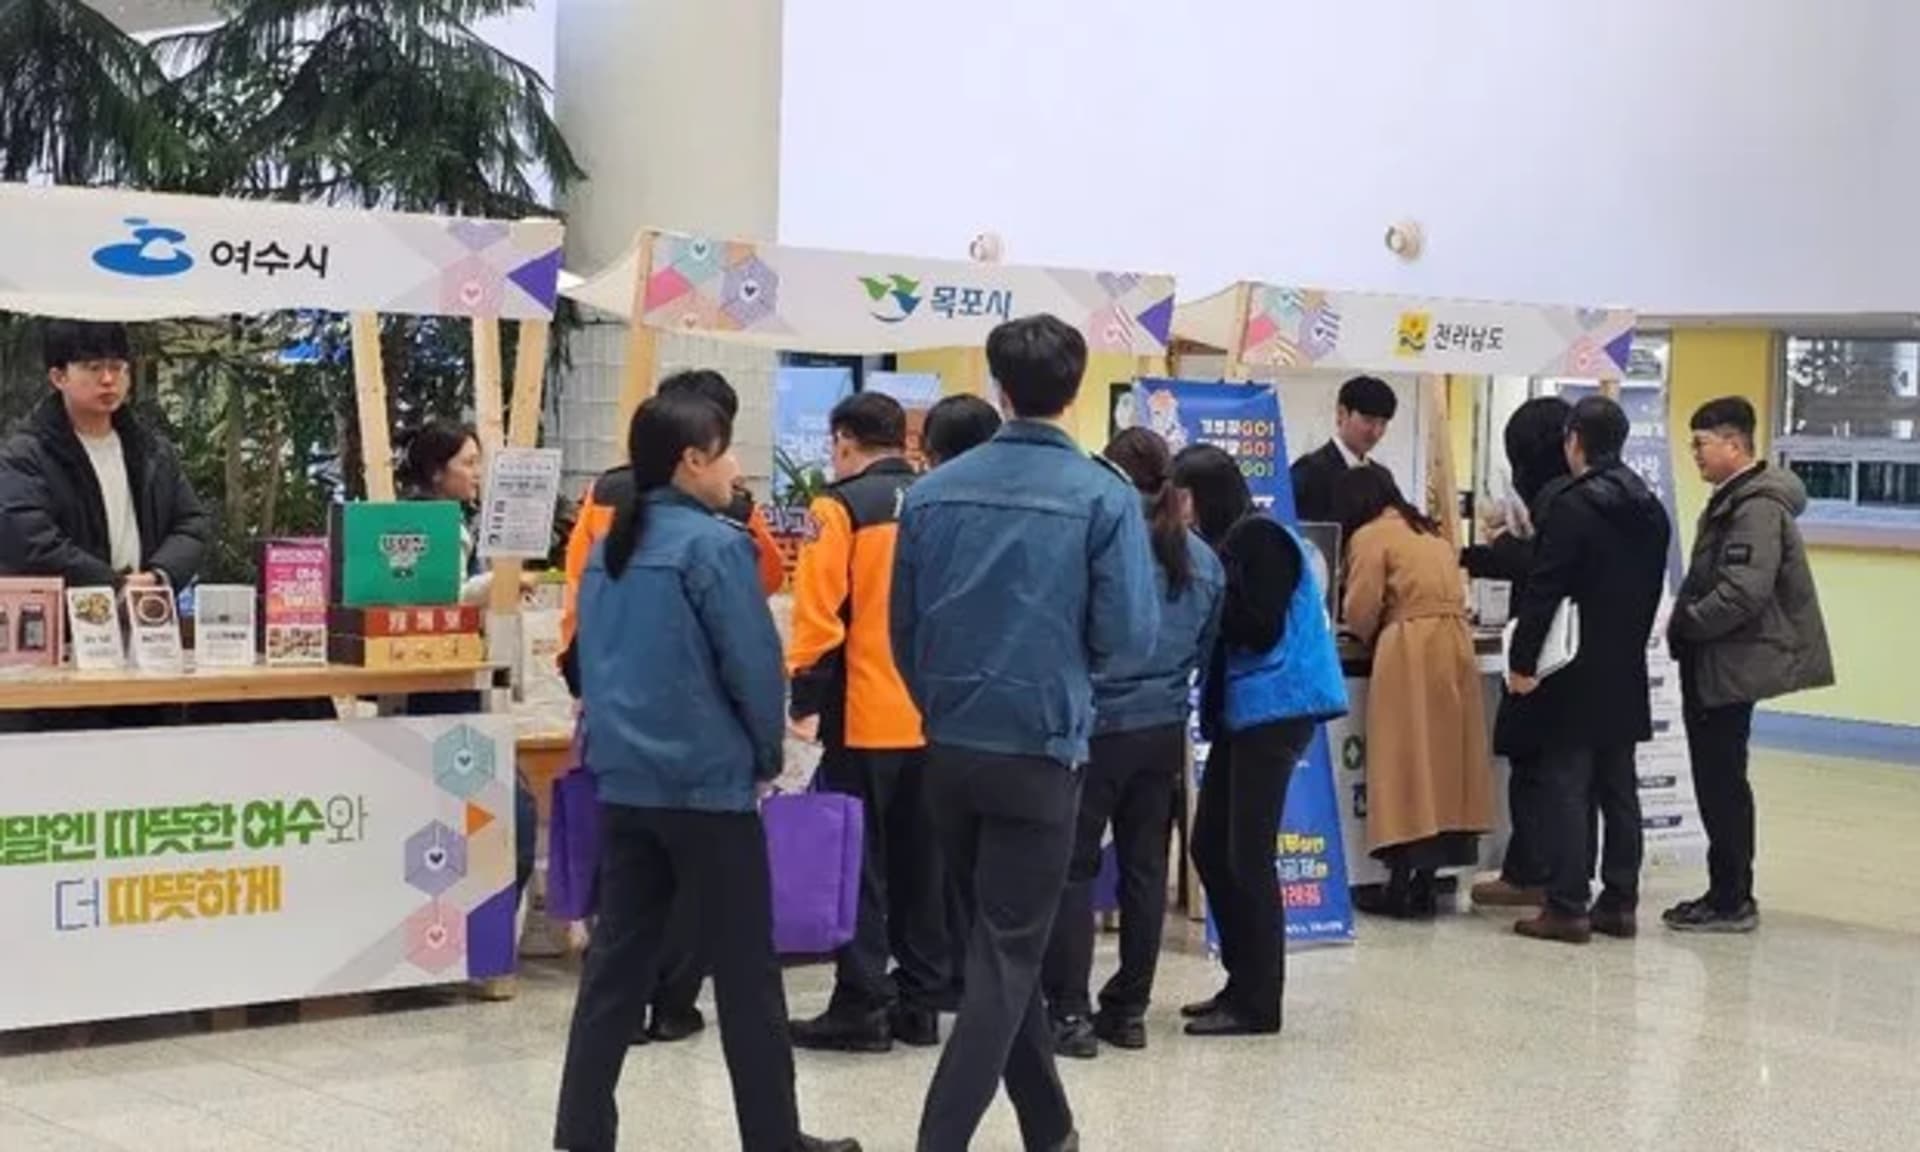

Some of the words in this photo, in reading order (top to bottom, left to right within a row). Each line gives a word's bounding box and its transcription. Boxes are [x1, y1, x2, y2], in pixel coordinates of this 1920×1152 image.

[210, 240, 328, 279] 여수시
[930, 286, 1012, 319] 목포시
[1433, 323, 1504, 352] 전라남도
[0, 811, 97, 866] 말엔
[104, 803, 236, 859] 따뜻한
[242, 794, 369, 848] 여수와
[55, 878, 100, 931] 더
[107, 865, 282, 926] 따뜻하게
